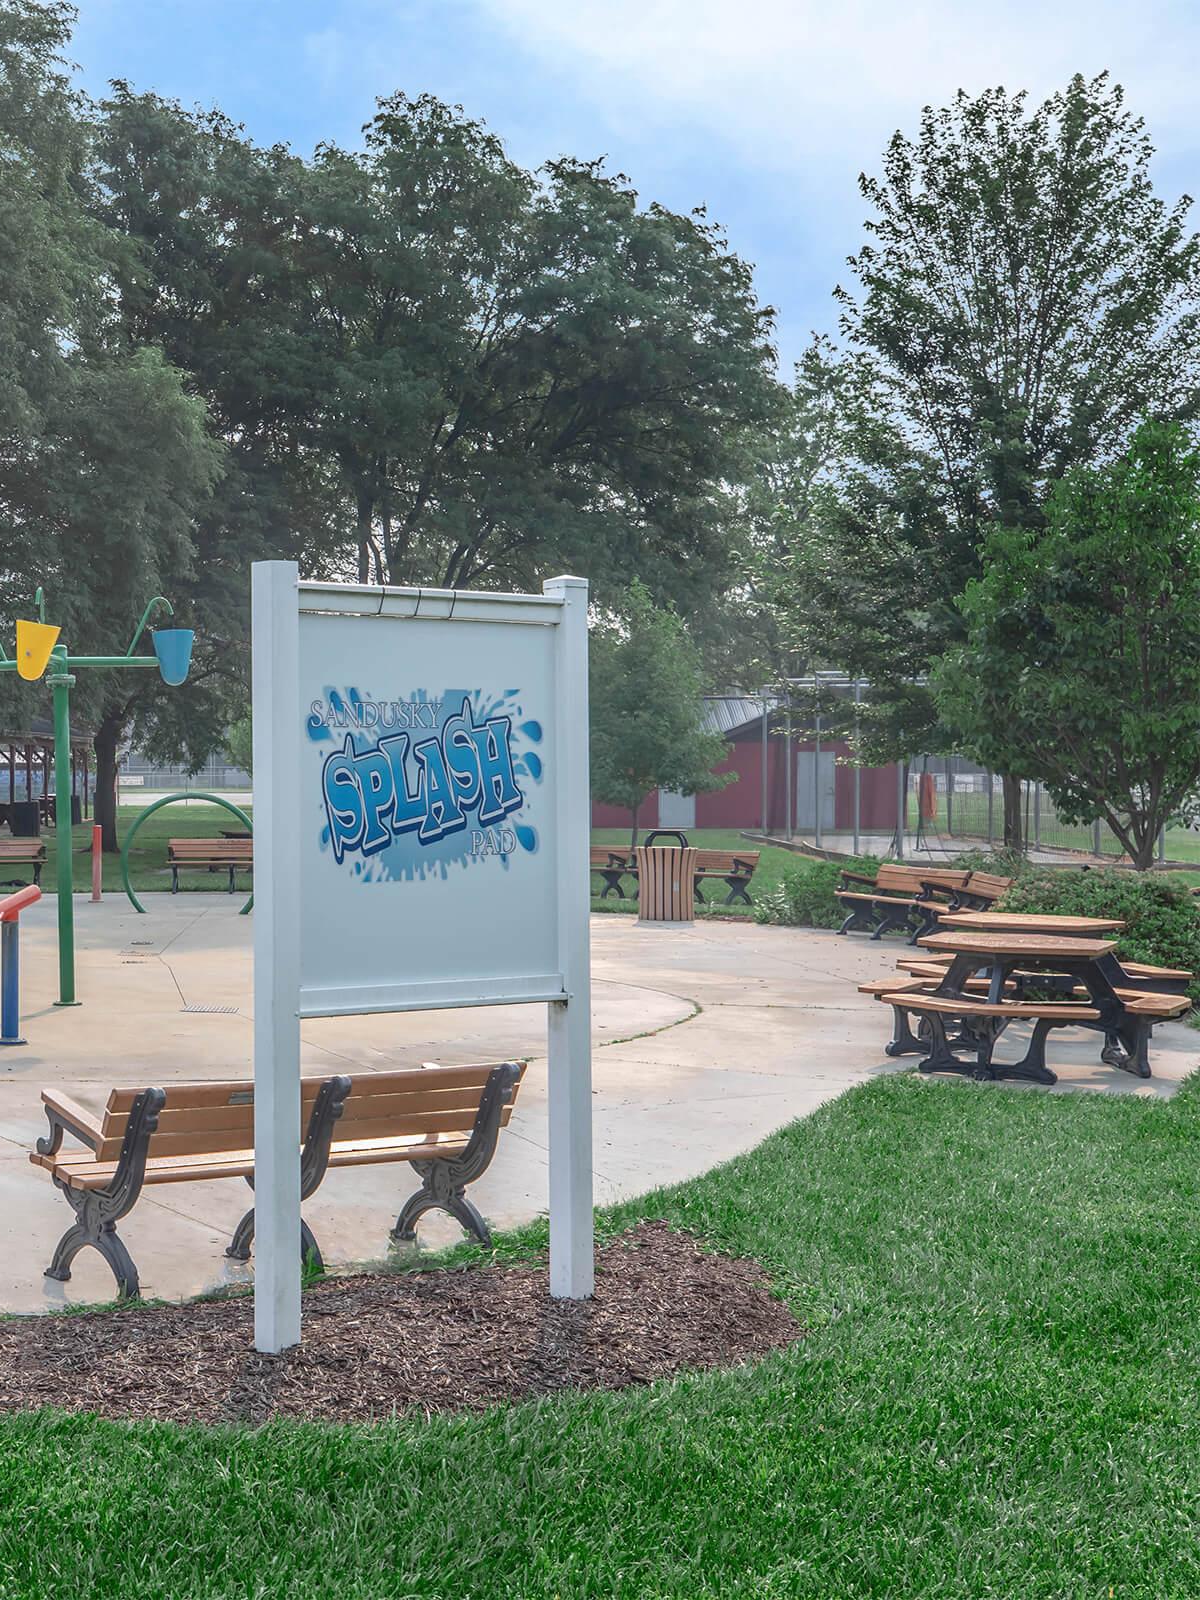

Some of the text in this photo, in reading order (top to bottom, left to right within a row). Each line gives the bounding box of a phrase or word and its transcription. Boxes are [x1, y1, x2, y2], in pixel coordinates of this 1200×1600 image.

[310, 699, 442, 729] SANDUSKY
[322, 695, 524, 865] SPLASH
[471, 829, 517, 856] PAD
